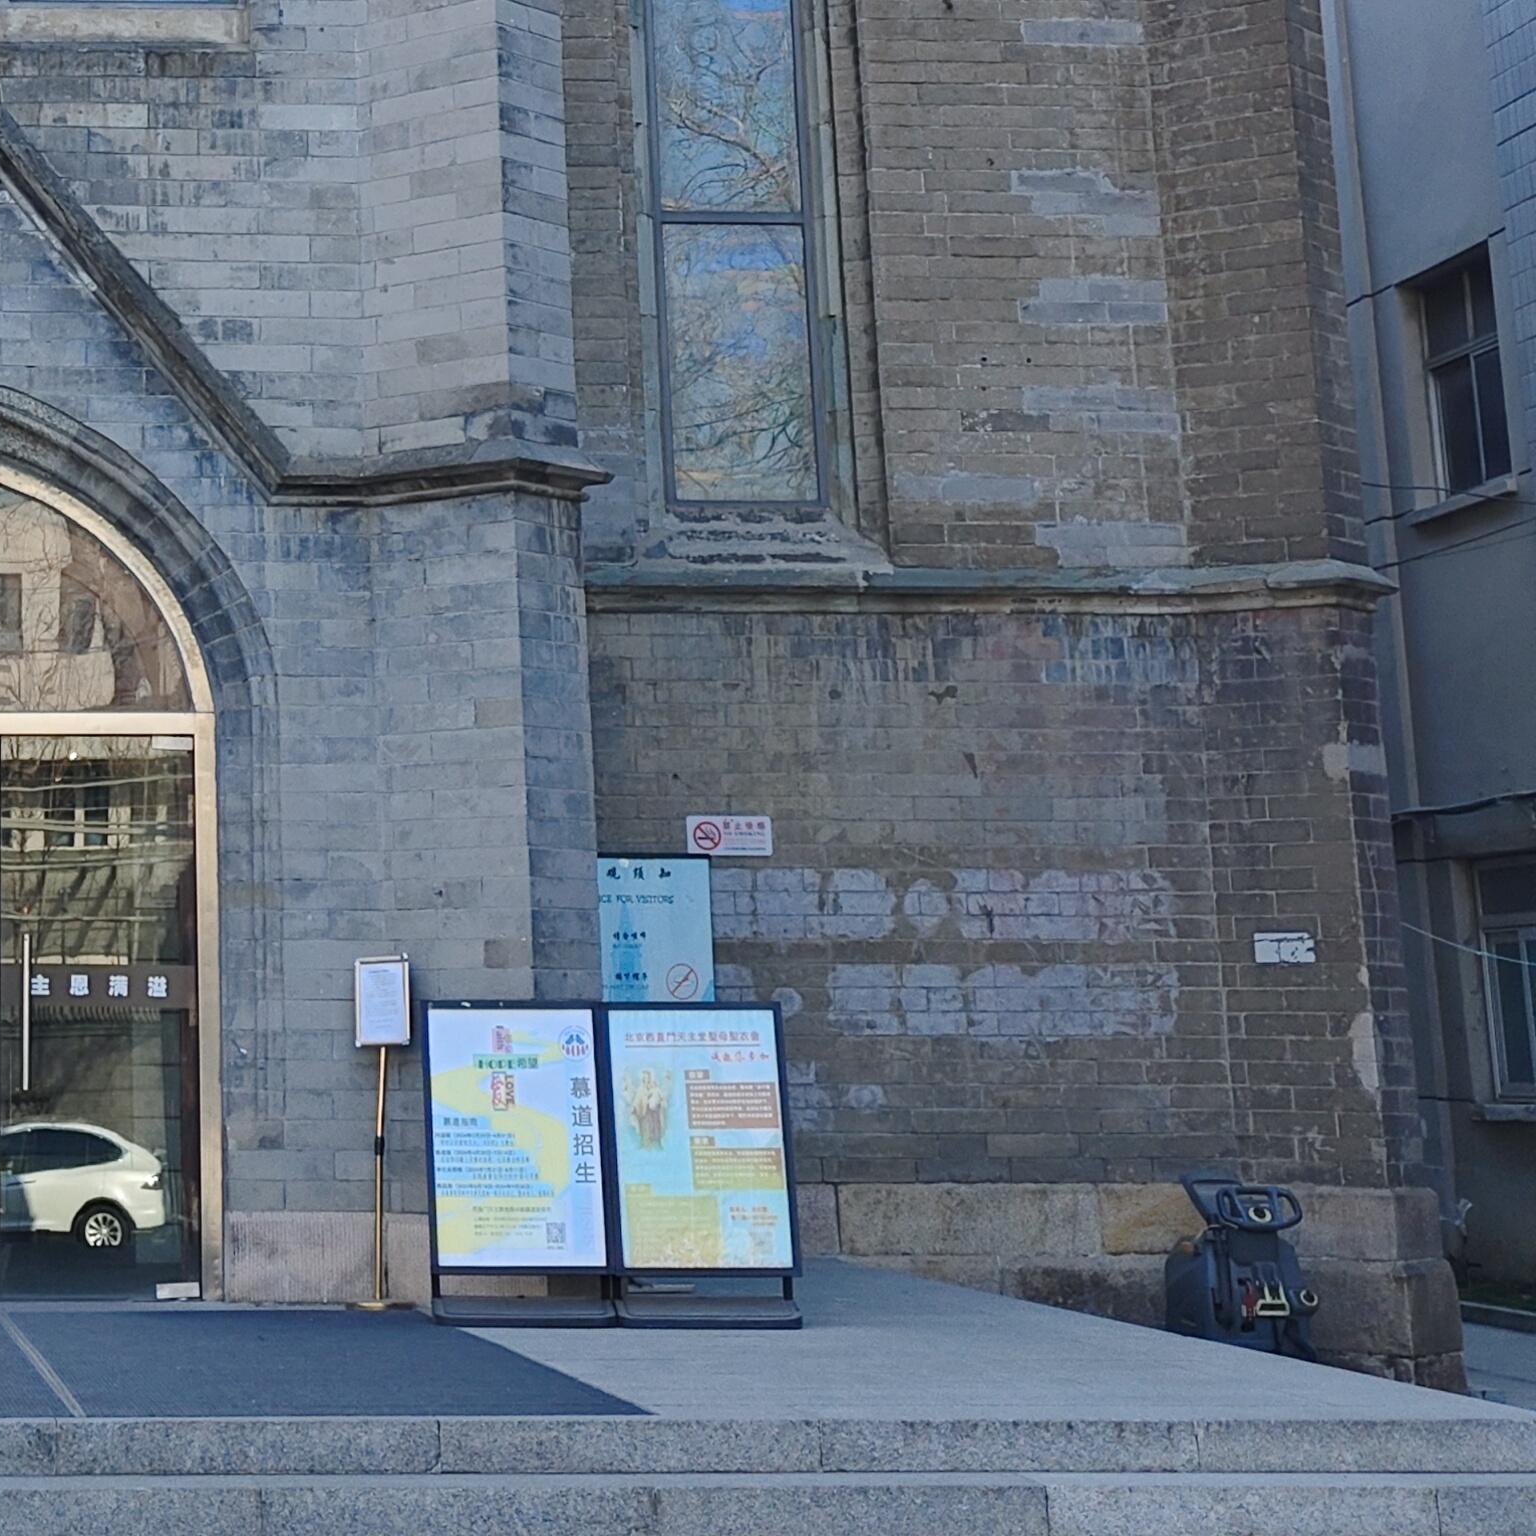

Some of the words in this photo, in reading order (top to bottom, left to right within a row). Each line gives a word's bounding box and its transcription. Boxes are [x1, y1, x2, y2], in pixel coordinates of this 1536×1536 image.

[616, 895, 633, 904] FOR
[636, 895, 675, 904] VISITORS
[30, 974, 168, 998] 主恩满溢
[505, 1074, 515, 1106] LOVE
[570, 1076, 597, 1184] 慕道招生
